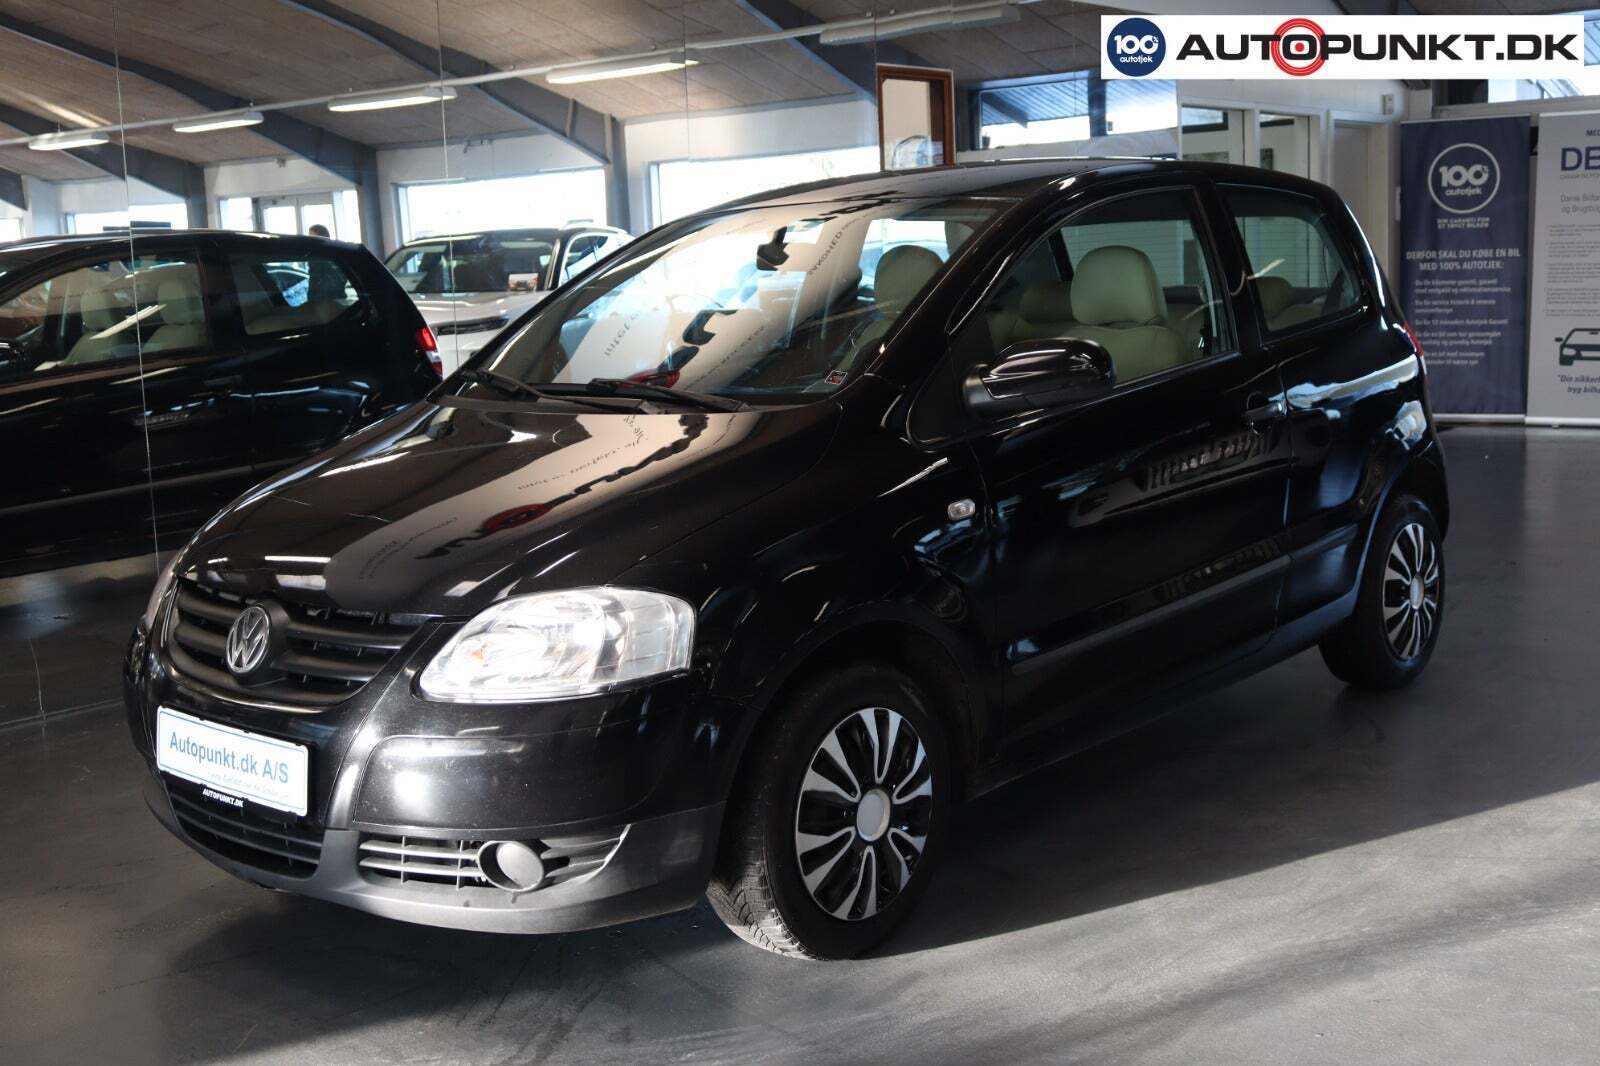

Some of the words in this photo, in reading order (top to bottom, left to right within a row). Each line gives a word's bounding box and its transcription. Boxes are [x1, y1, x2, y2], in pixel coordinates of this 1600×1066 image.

[1406, 250, 1437, 260] DERFOR
[1439, 250, 1457, 259] SKAL
[1459, 249, 1471, 258] DU
[1472, 249, 1493, 258] KØBE
[1495, 248, 1507, 257] EN
[1508, 248, 1520, 257] BIL
[1419, 262, 1438, 271] MED
[1440, 262, 1460, 270] 100%
[169, 731, 259, 775] Autopunkt.dk
[262, 759, 289, 784] A/S
[202, 788, 244, 808] AUTOPUNKT.DK
